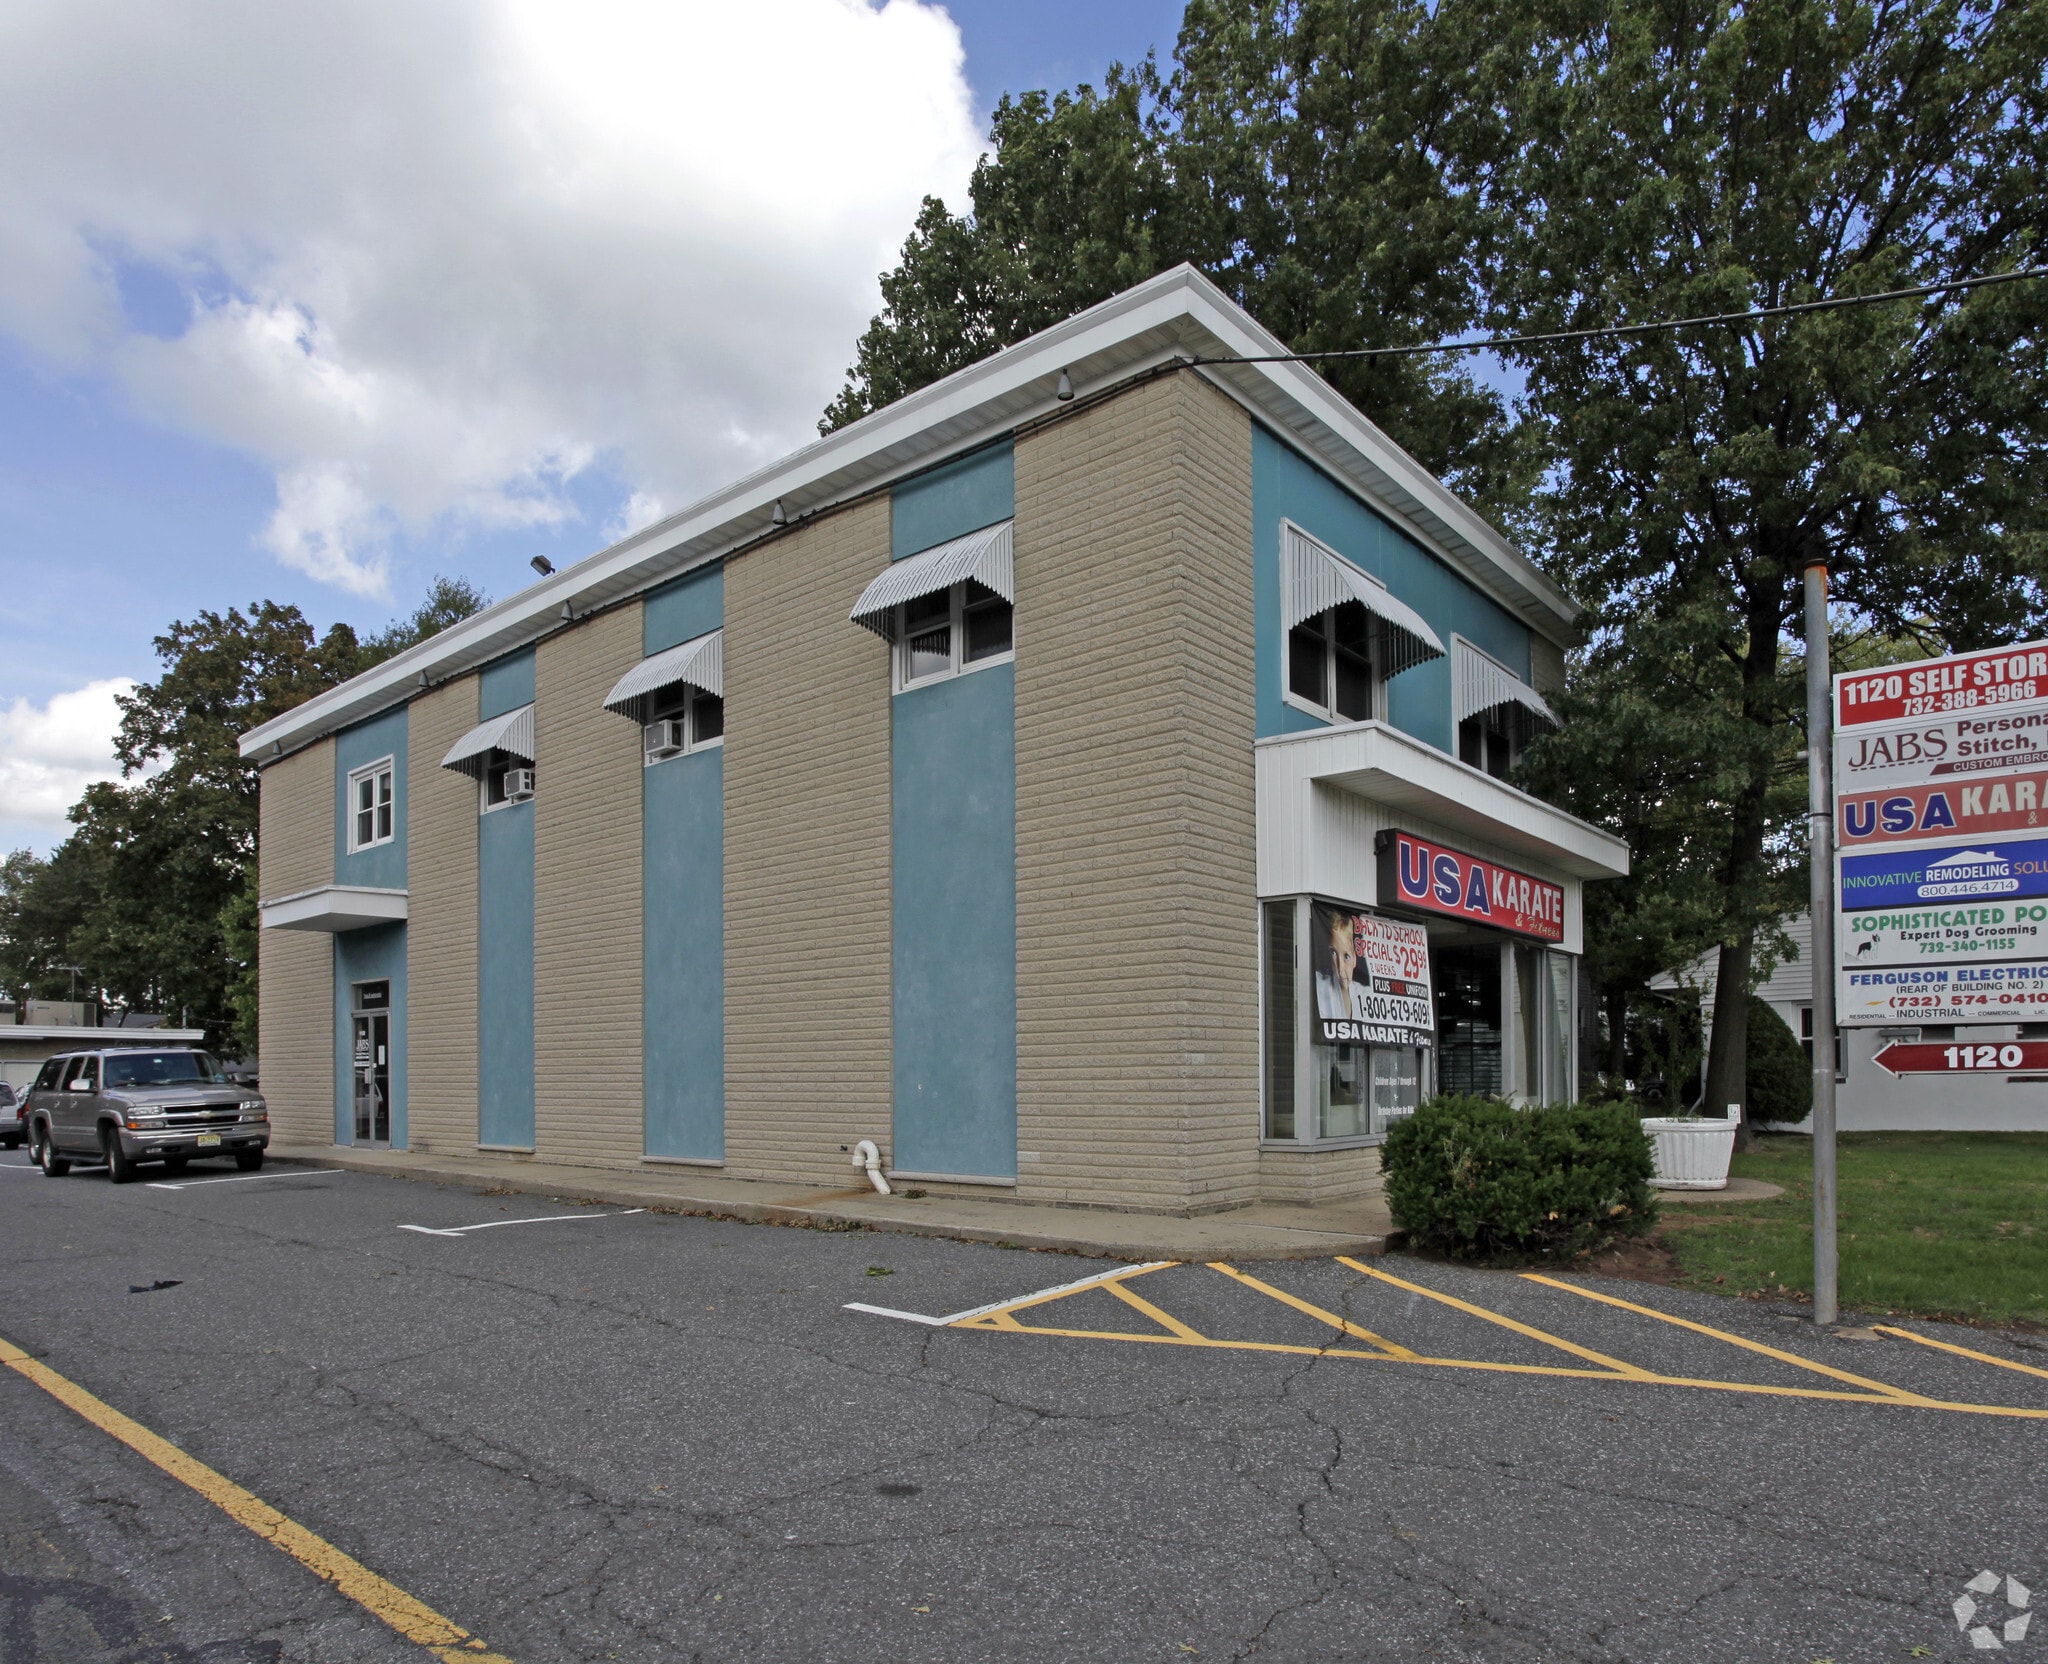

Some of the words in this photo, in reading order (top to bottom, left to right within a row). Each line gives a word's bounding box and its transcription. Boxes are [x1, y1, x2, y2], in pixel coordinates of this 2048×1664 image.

[1844, 675, 1903, 705] 1120
[1909, 664, 1968, 696] SELF
[1902, 680, 2037, 717] 732-388-5966
[1848, 729, 1948, 768] JABS
[1957, 734, 2037, 756] Stitch,
[1953, 758, 2003, 772] CUSTOM
[1843, 792, 1958, 838] USA
[2027, 811, 2038, 825] &
[1399, 840, 1492, 916] USA
[1492, 869, 1561, 924] KARATE
[1843, 871, 1922, 889] INNOVATIVE
[1926, 864, 2010, 882] REMODELING
[1921, 880, 2015, 897] 800.446.4714
[1515, 912, 1523, 928] &
[1852, 908, 2005, 933] SOPHISTICATED
[2015, 905, 2047, 923] PO
[1352, 915, 1378, 938] BACK
[1378, 922, 1392, 940] TO
[1394, 925, 1425, 947] SCHOOL
[1900, 929, 1940, 942] Expert
[1946, 928, 1969, 940] Dog
[1975, 925, 2038, 937] Grooming
[1354, 936, 1393, 962] SPECIAL
[1920, 938, 2016, 954] 732-340-1155
[1370, 962, 1374, 973] 2
[1376, 963, 1396, 976] WEEKS
[1850, 971, 1948, 986] FERGUSON
[1956, 966, 2048, 982] ELECTRIC
[1374, 979, 1391, 992] PLUS
[1896, 985, 1928, 994] (REAR
[1932, 984, 1948, 992] OF
[1952, 982, 2003, 992] BUILDING
[2007, 981, 2028, 990] NO.
[2032, 980, 2044, 990] 2)
[1888, 995, 1942, 1008] (732)
[1950, 993, 2048, 1006] 574-0410
[1896, 1008, 1966, 1018] INDUSTRIAL
[1323, 1022, 1360, 1040] USA
[1362, 1024, 1409, 1044] KARATE
[1944, 1045, 2024, 1068] 1120
